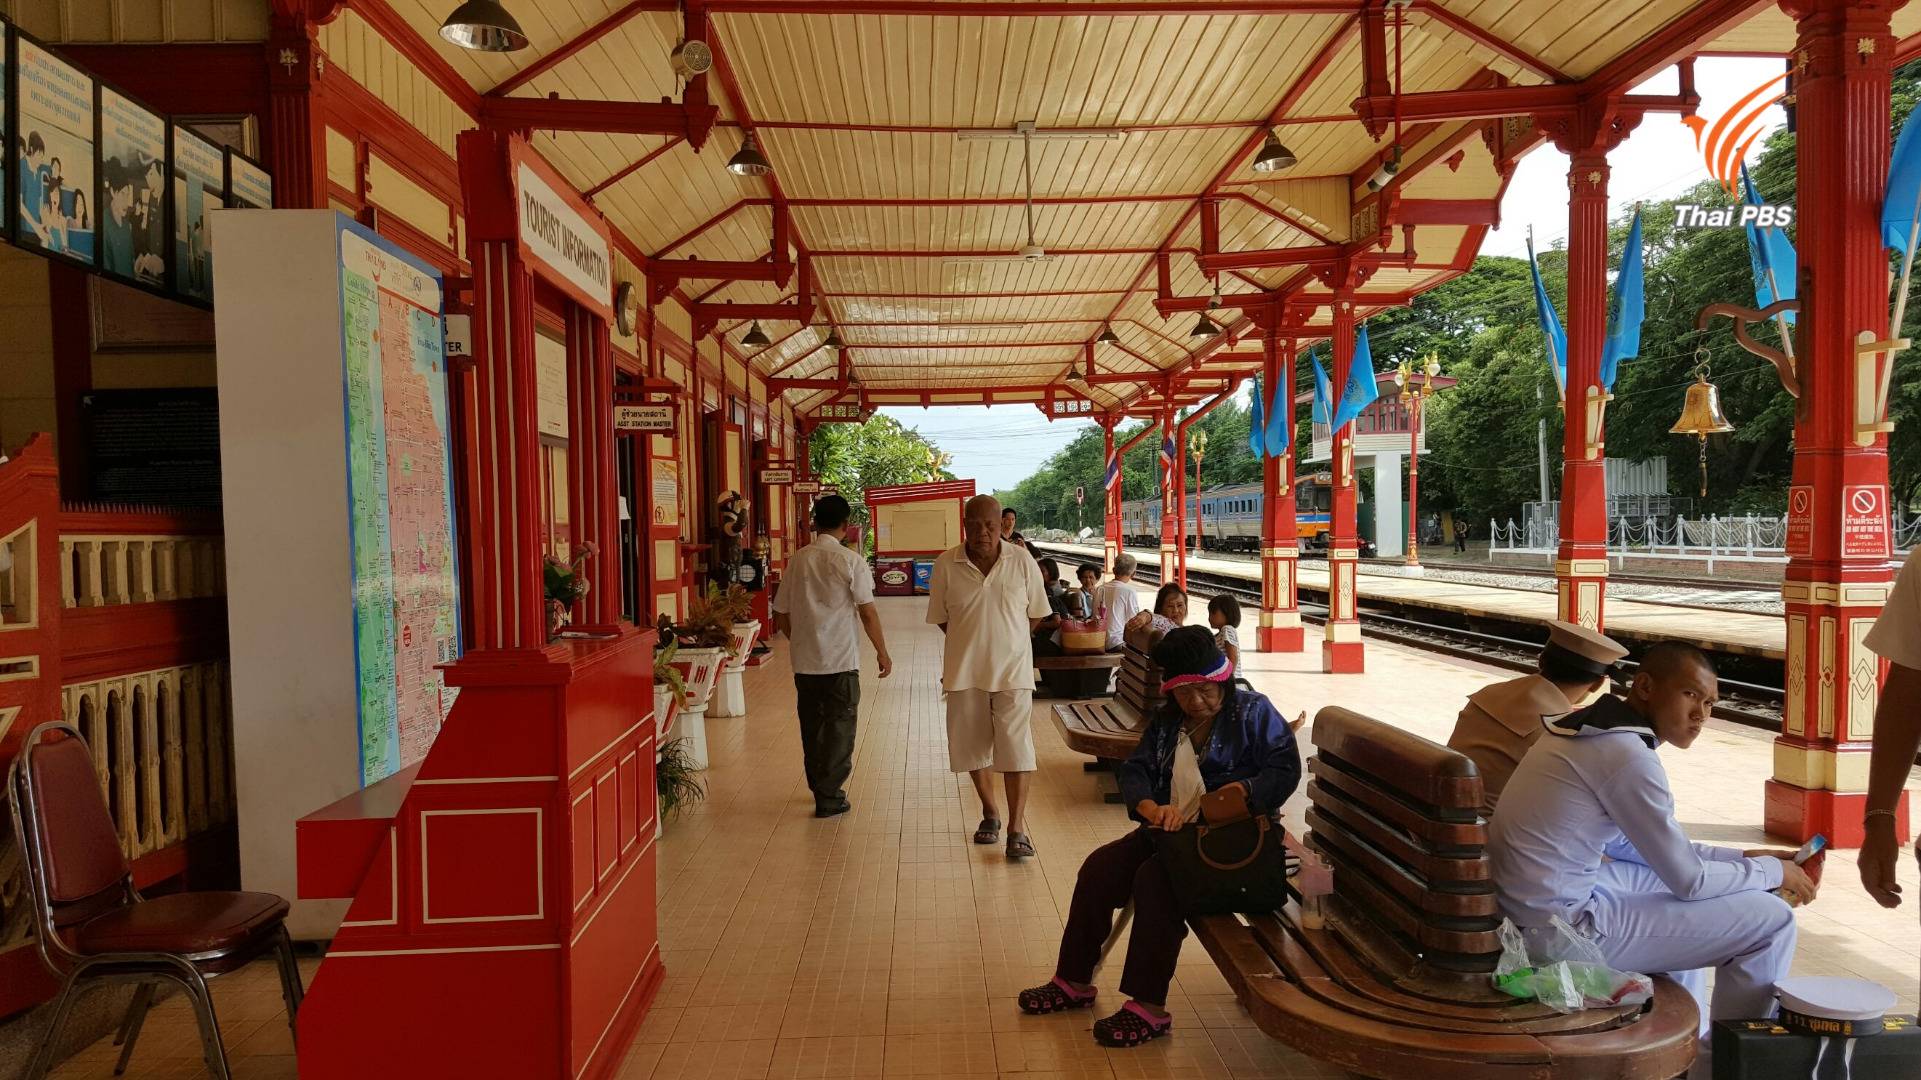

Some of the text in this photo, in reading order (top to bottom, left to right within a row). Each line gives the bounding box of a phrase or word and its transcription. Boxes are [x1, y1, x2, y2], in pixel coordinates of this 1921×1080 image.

[524, 191, 608, 291] TOURIST INFORMATION
[445, 341, 463, 353] ER
